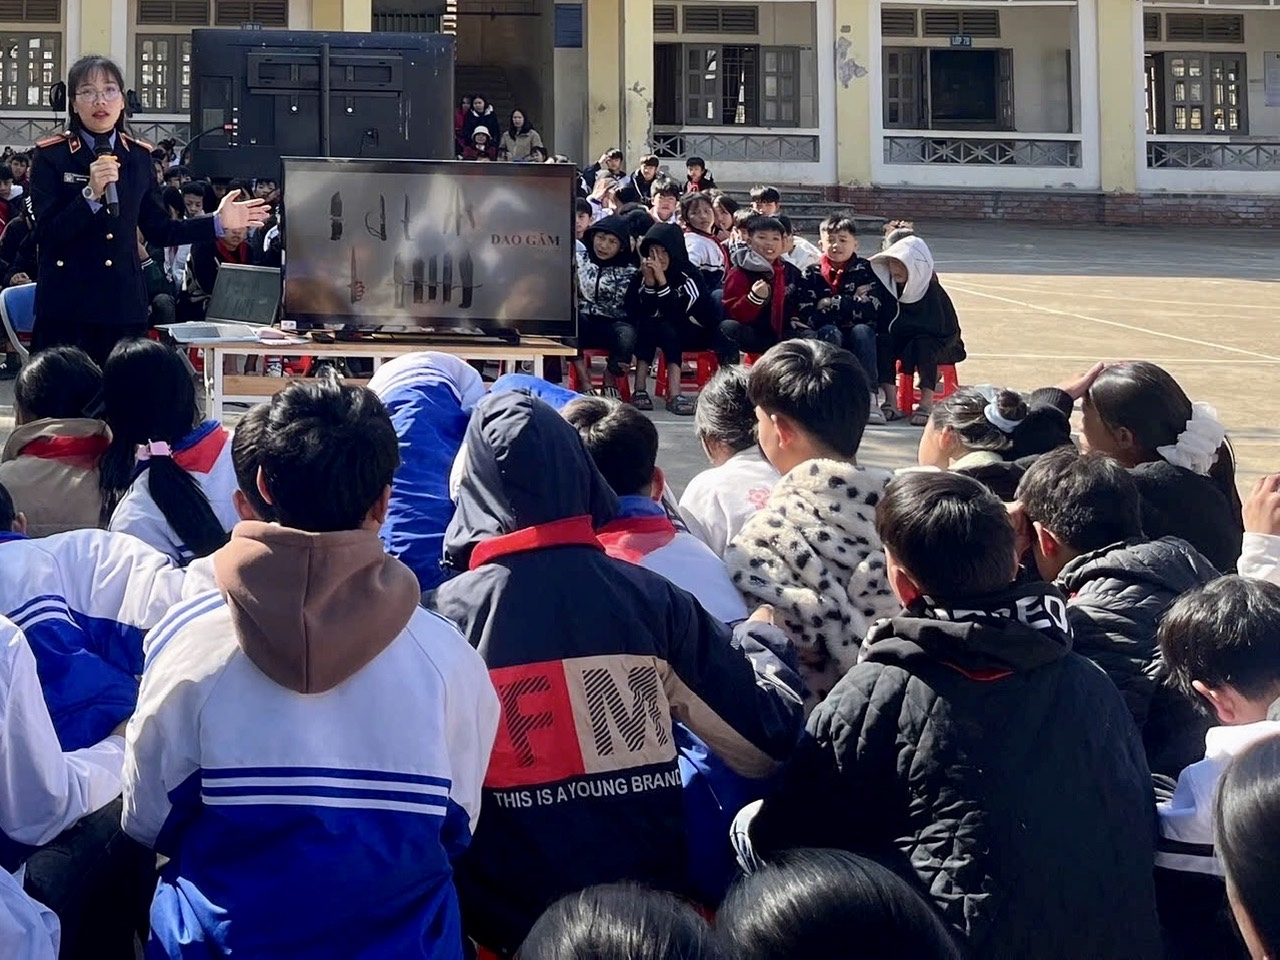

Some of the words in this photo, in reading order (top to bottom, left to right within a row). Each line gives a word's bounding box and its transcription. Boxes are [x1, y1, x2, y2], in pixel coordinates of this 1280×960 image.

[491, 233, 522, 246] DAO
[493, 791, 532, 808] THIS
[537, 789, 552, 805] IS
[556, 786, 568, 803] A
[568, 777, 628, 800] YOUNG
[631, 768, 682, 792] BRAND
